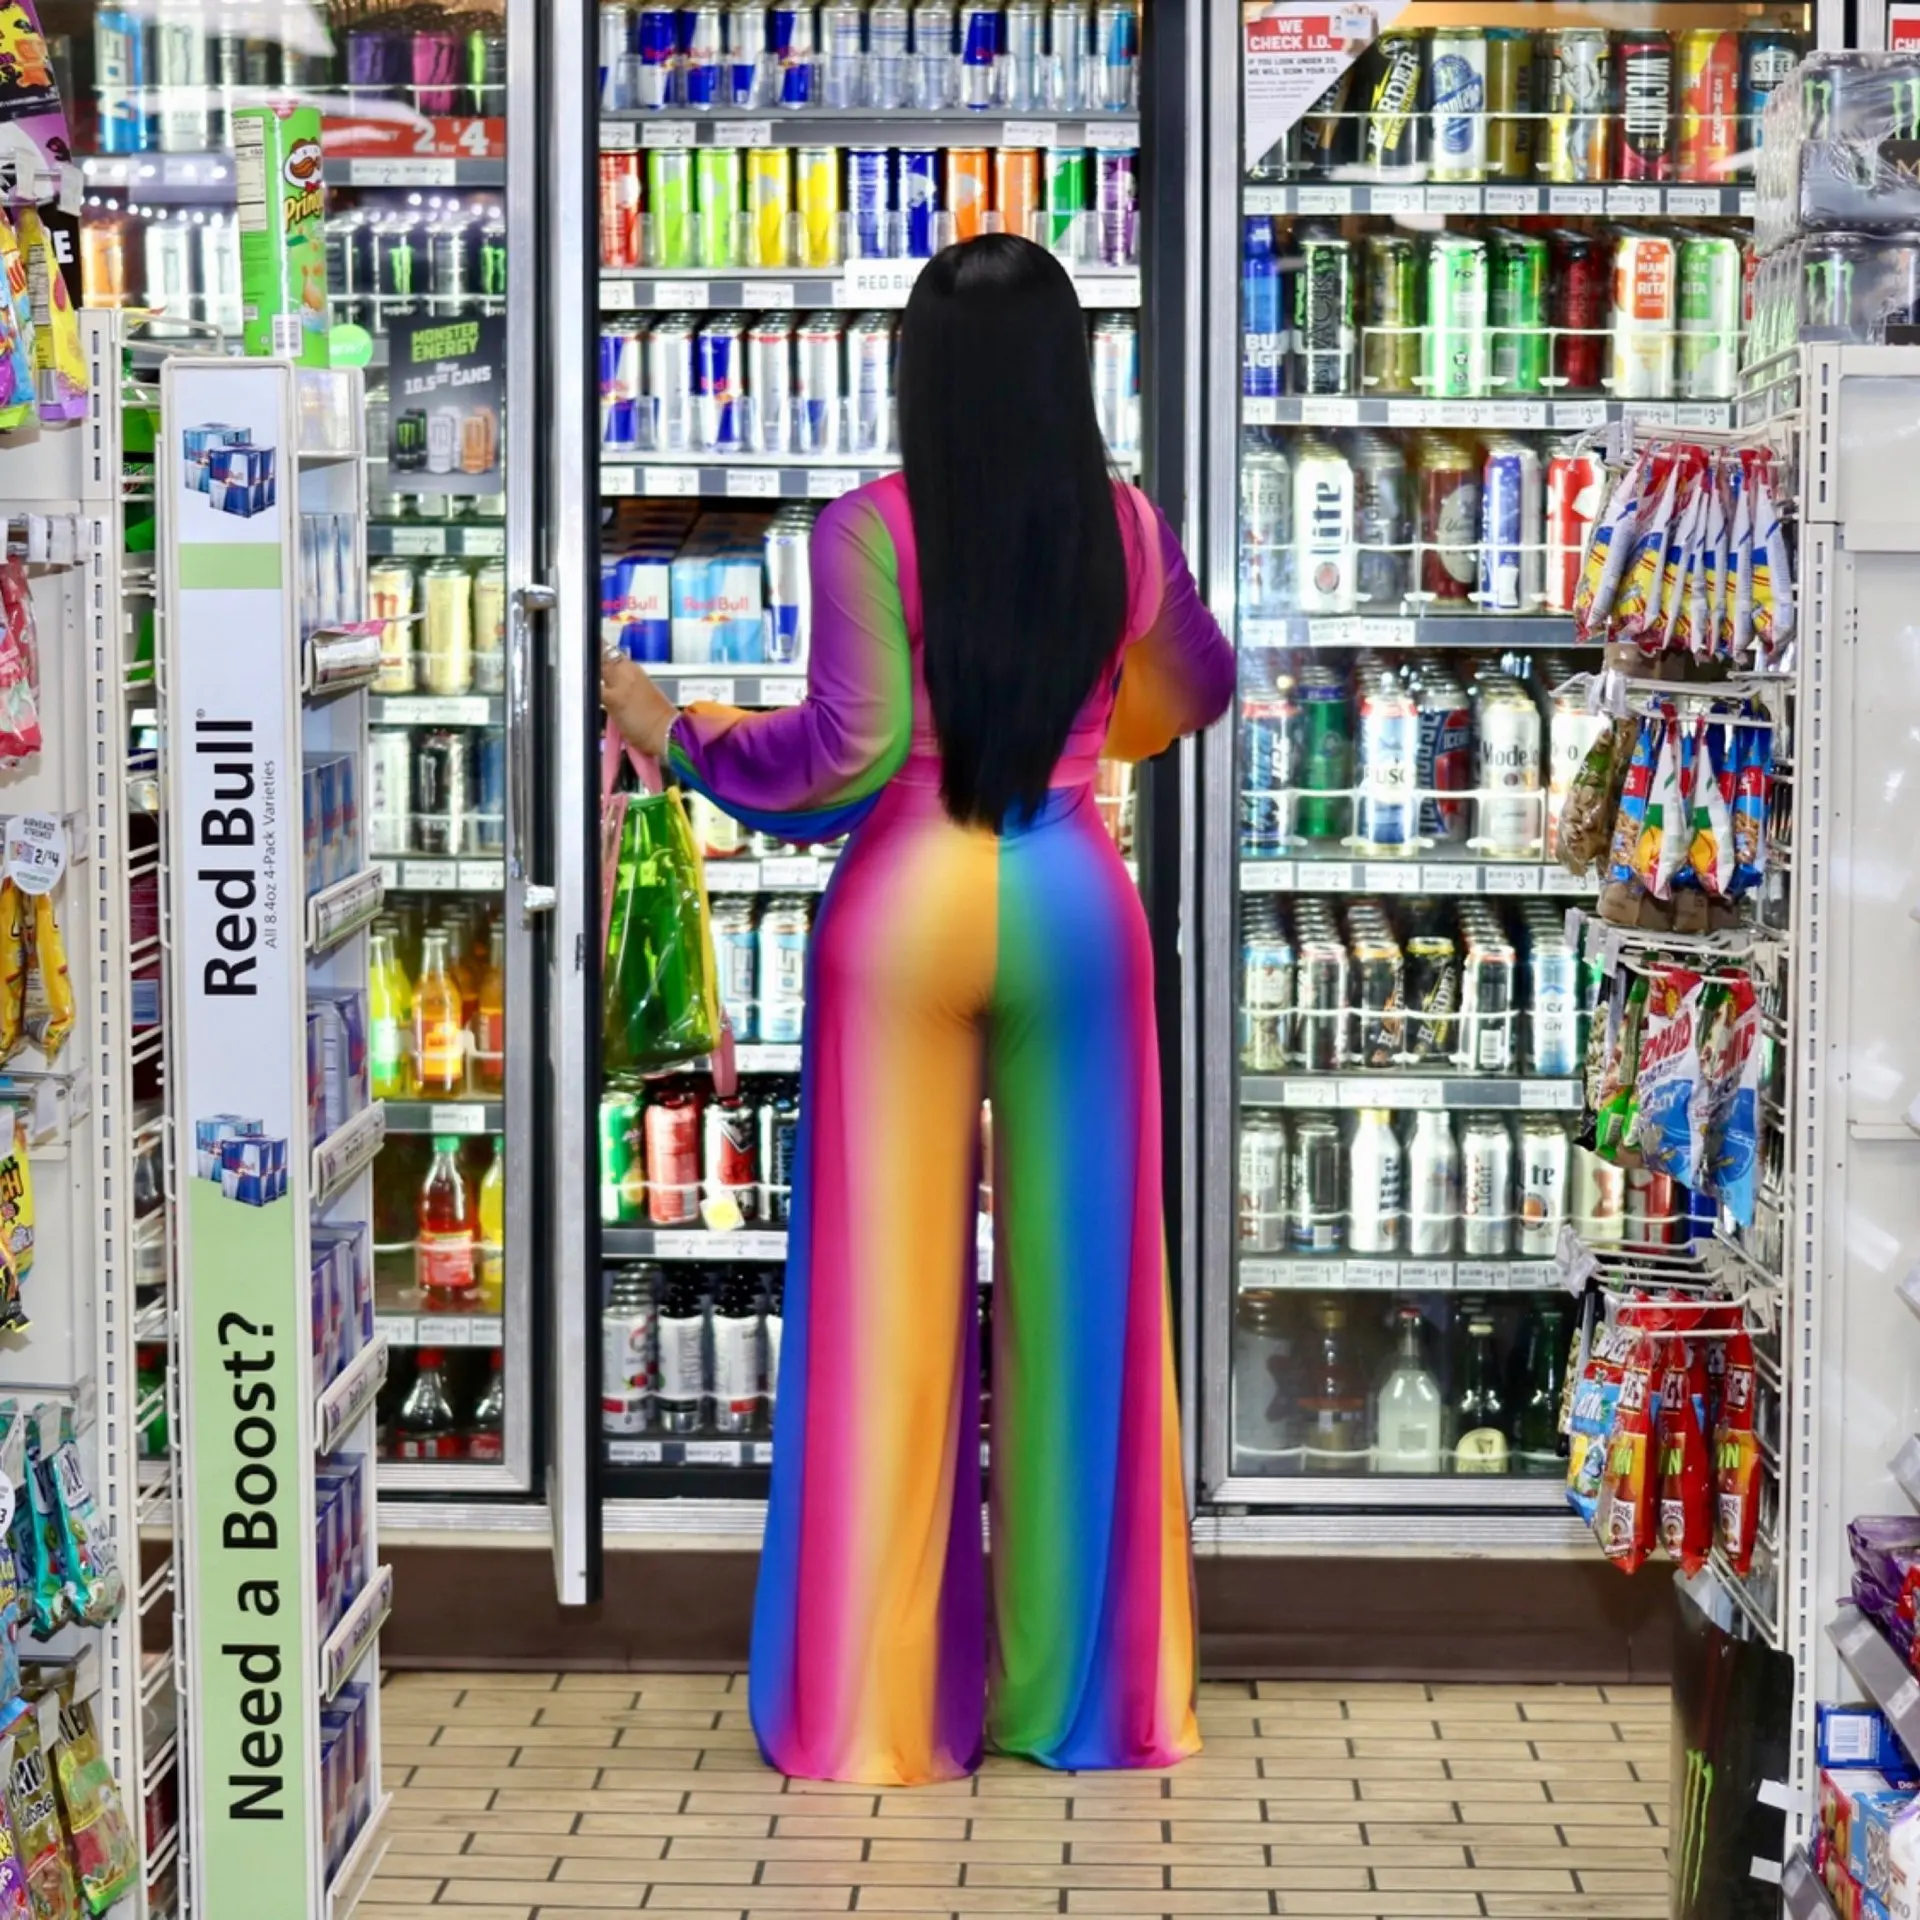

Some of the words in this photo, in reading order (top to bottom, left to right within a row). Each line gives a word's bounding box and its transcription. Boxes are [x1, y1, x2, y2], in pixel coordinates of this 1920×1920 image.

[1250, 36, 1303, 51] CHECK
[1278, 19, 1304, 34] WE
[1297, 57, 1322, 65] UNDER
[1624, 57, 1671, 134] WICKED
[413, 119, 436, 154] 2
[857, 275, 888, 291] RED
[412, 338, 478, 363] ENERGY
[1311, 481, 1342, 555] lite
[627, 595, 658, 611] Bull
[718, 595, 749, 611] Bull
[195, 720, 255, 846] Bull
[262, 760, 277, 826] Varieties
[263, 832, 277, 879] 4-Pack
[263, 883, 277, 925] 8.4oz
[198, 869, 257, 996] Red
[264, 928, 277, 949] All
[217, 1311, 278, 1550] Boost?
[238, 1580, 280, 1617] a
[222, 1644, 284, 1820] Need
